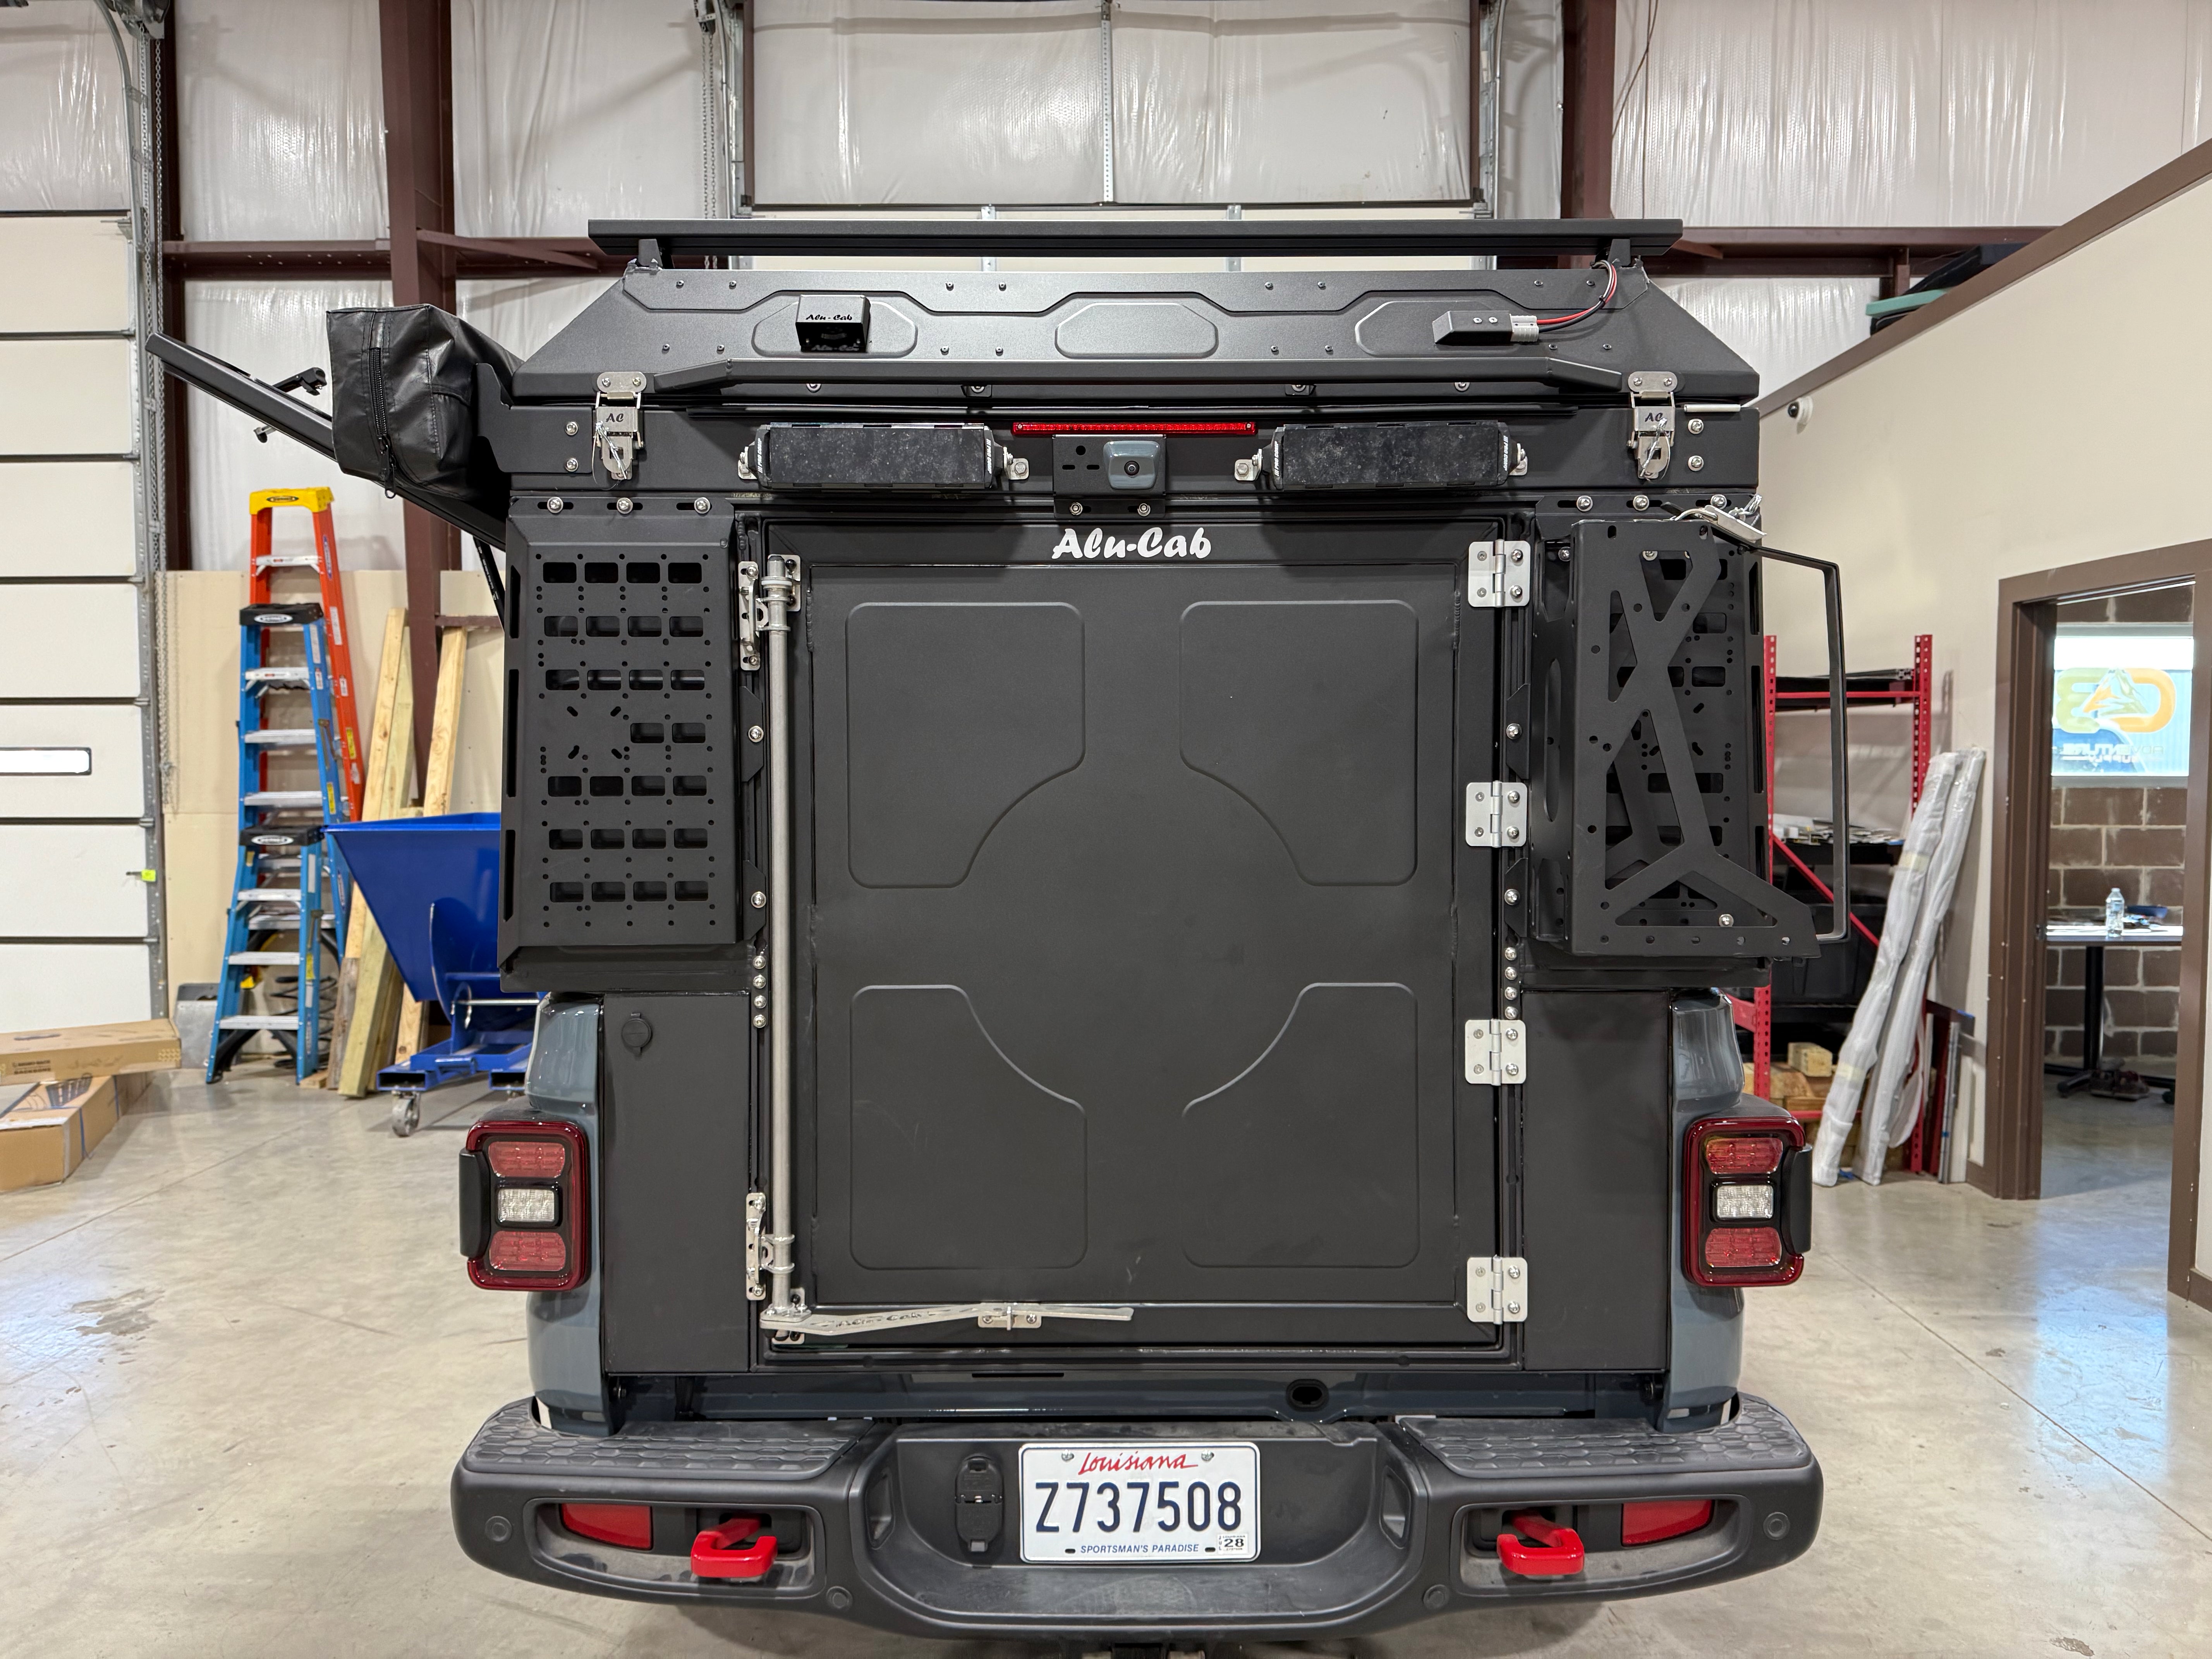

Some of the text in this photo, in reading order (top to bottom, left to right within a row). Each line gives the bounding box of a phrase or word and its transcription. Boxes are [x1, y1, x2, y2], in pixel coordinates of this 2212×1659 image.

[605, 412, 624, 422] AC
[1051, 527, 1211, 559] Alu-Cab
[1078, 1451, 1199, 1475] Louisiana
[1036, 1481, 1242, 1532] Z737508
[1080, 1543, 1199, 1553] SPORTSMAN'S PARADISE
[1224, 1538, 1244, 1547] 28
